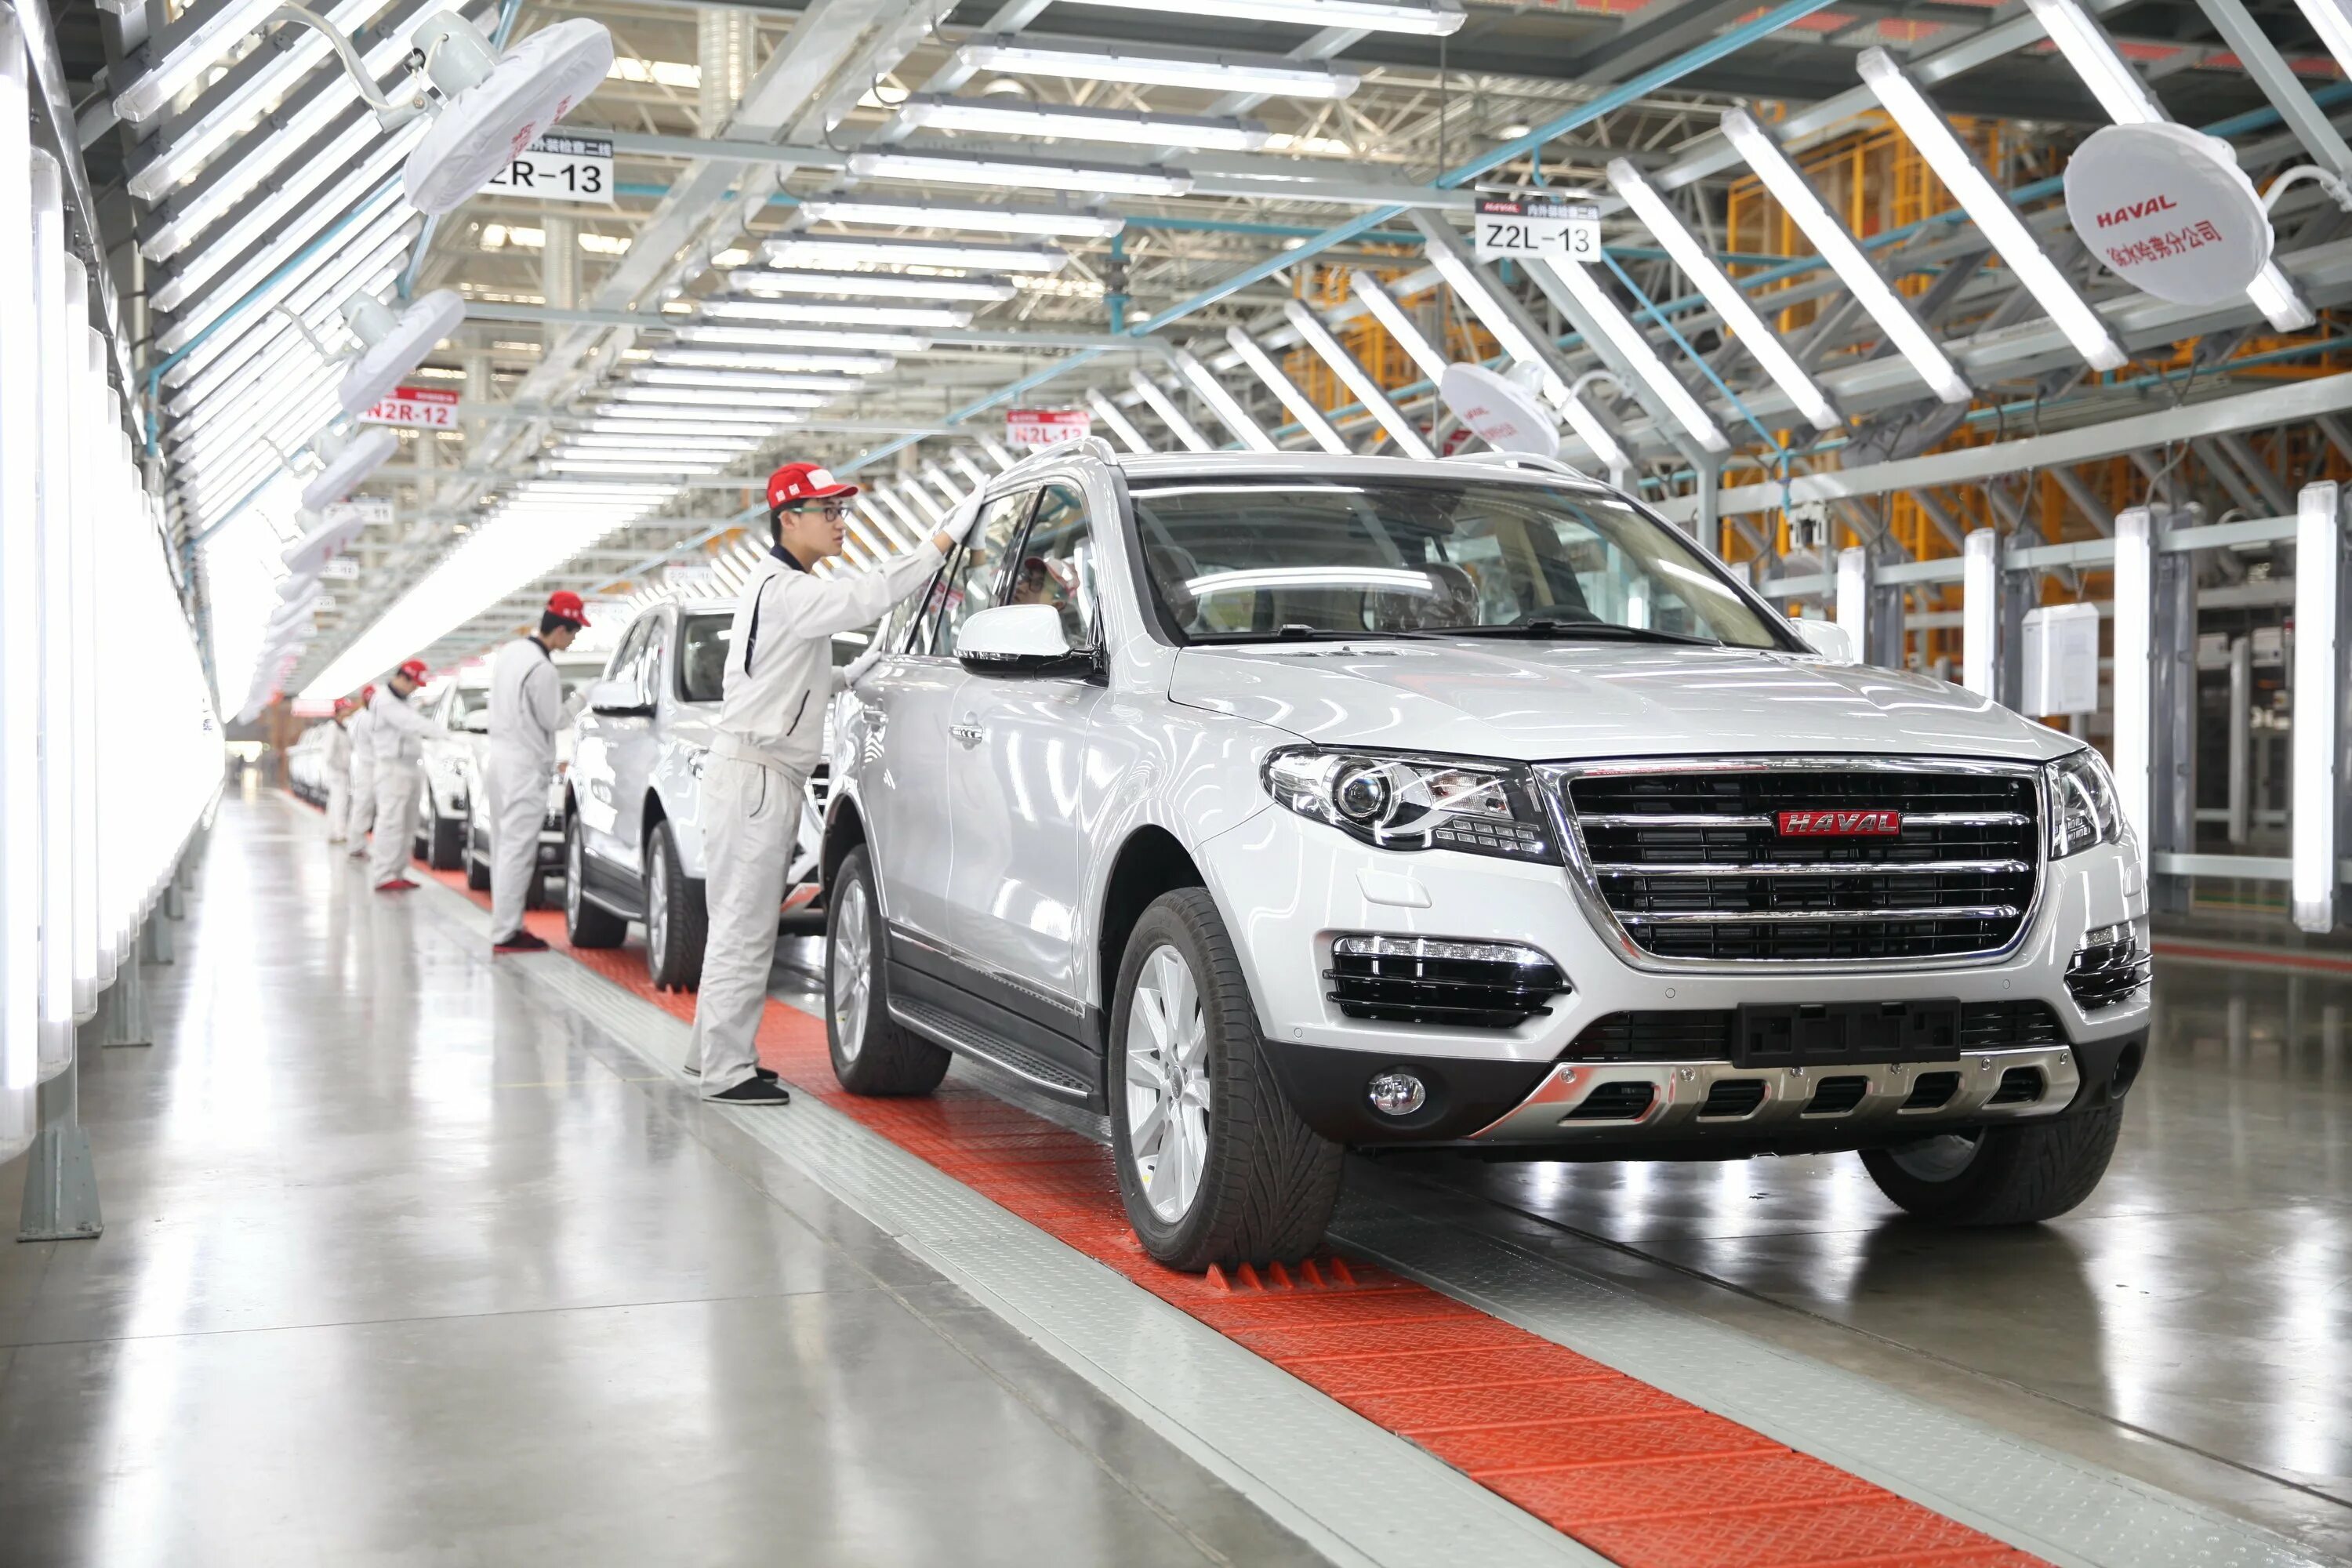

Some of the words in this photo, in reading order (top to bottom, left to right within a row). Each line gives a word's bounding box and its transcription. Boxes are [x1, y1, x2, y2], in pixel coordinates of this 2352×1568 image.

[2096, 195, 2177, 228] HAVAL
[1486, 224, 1590, 252] Z2L-13
[366, 401, 448, 425] N2R-12
[1786, 814, 1896, 833] HAVAL
